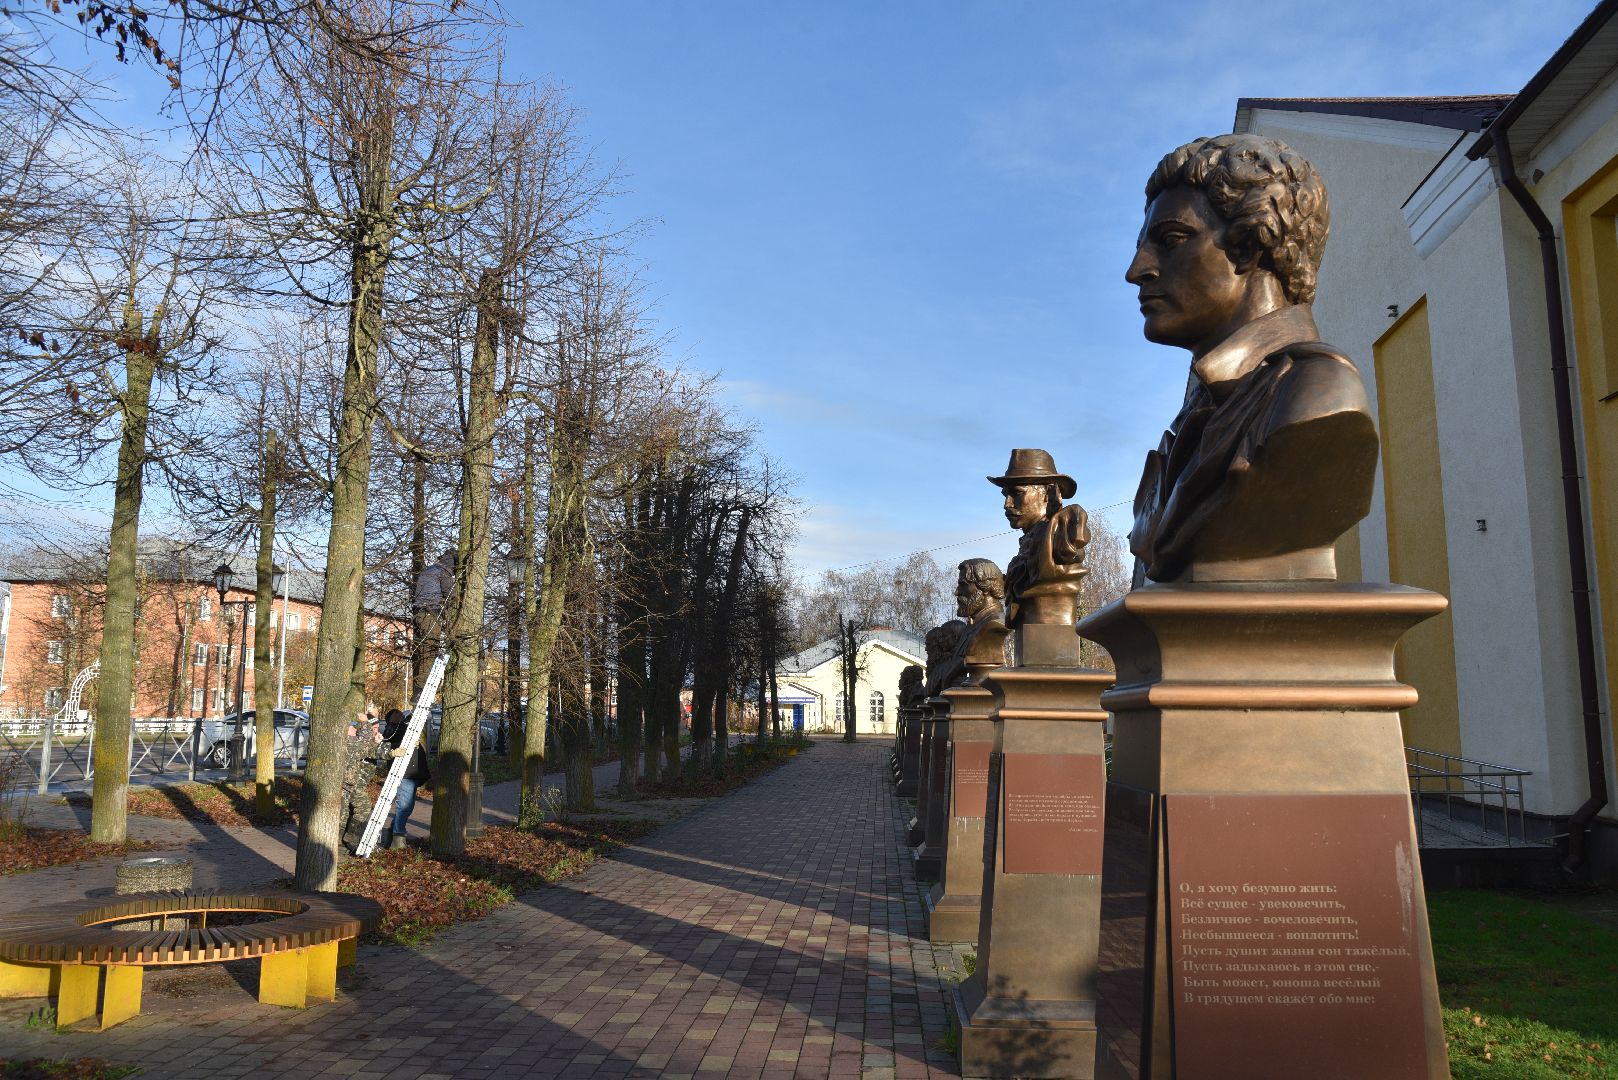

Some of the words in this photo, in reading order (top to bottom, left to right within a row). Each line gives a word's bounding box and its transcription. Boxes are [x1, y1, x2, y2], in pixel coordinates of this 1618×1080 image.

[1180, 882, 1194, 895] О,
[1198, 885, 1205, 893] я
[1208, 885, 1239, 895] хочу
[1242, 882, 1296, 895] безумно
[1299, 885, 1337, 893] жить:
[1181, 898, 1204, 909] Всё
[1207, 900, 1248, 911] сущее
[1259, 900, 1346, 911] увековечить,
[1181, 913, 1252, 925] Безличное
[1263, 916, 1358, 925] вочеловечить,
[1182, 929, 1274, 940] Несбывшееся
[1286, 929, 1359, 940] воплотить!
[1182, 944, 1221, 957] Пусть
[1225, 948, 1267, 958] душит
[1271, 948, 1314, 956] жизни
[1318, 948, 1341, 956] сон
[1344, 945, 1411, 957] тяжёлый,
[1183, 960, 1222, 973] Пусть
[1225, 963, 1300, 972] задыхаюсь
[1314, 963, 1346, 972] этом
[1183, 976, 1219, 987] Быть
[1222, 979, 1269, 989] может,
[1272, 979, 1320, 987] юноша
[1323, 977, 1381, 987] весёлый
[1184, 992, 1194, 1002] В
[1197, 995, 1263, 1005] грядущем
[1267, 995, 1315, 1004] скажет
[1319, 993, 1343, 1004] обо
[1345, 995, 1376, 1004] мне:
